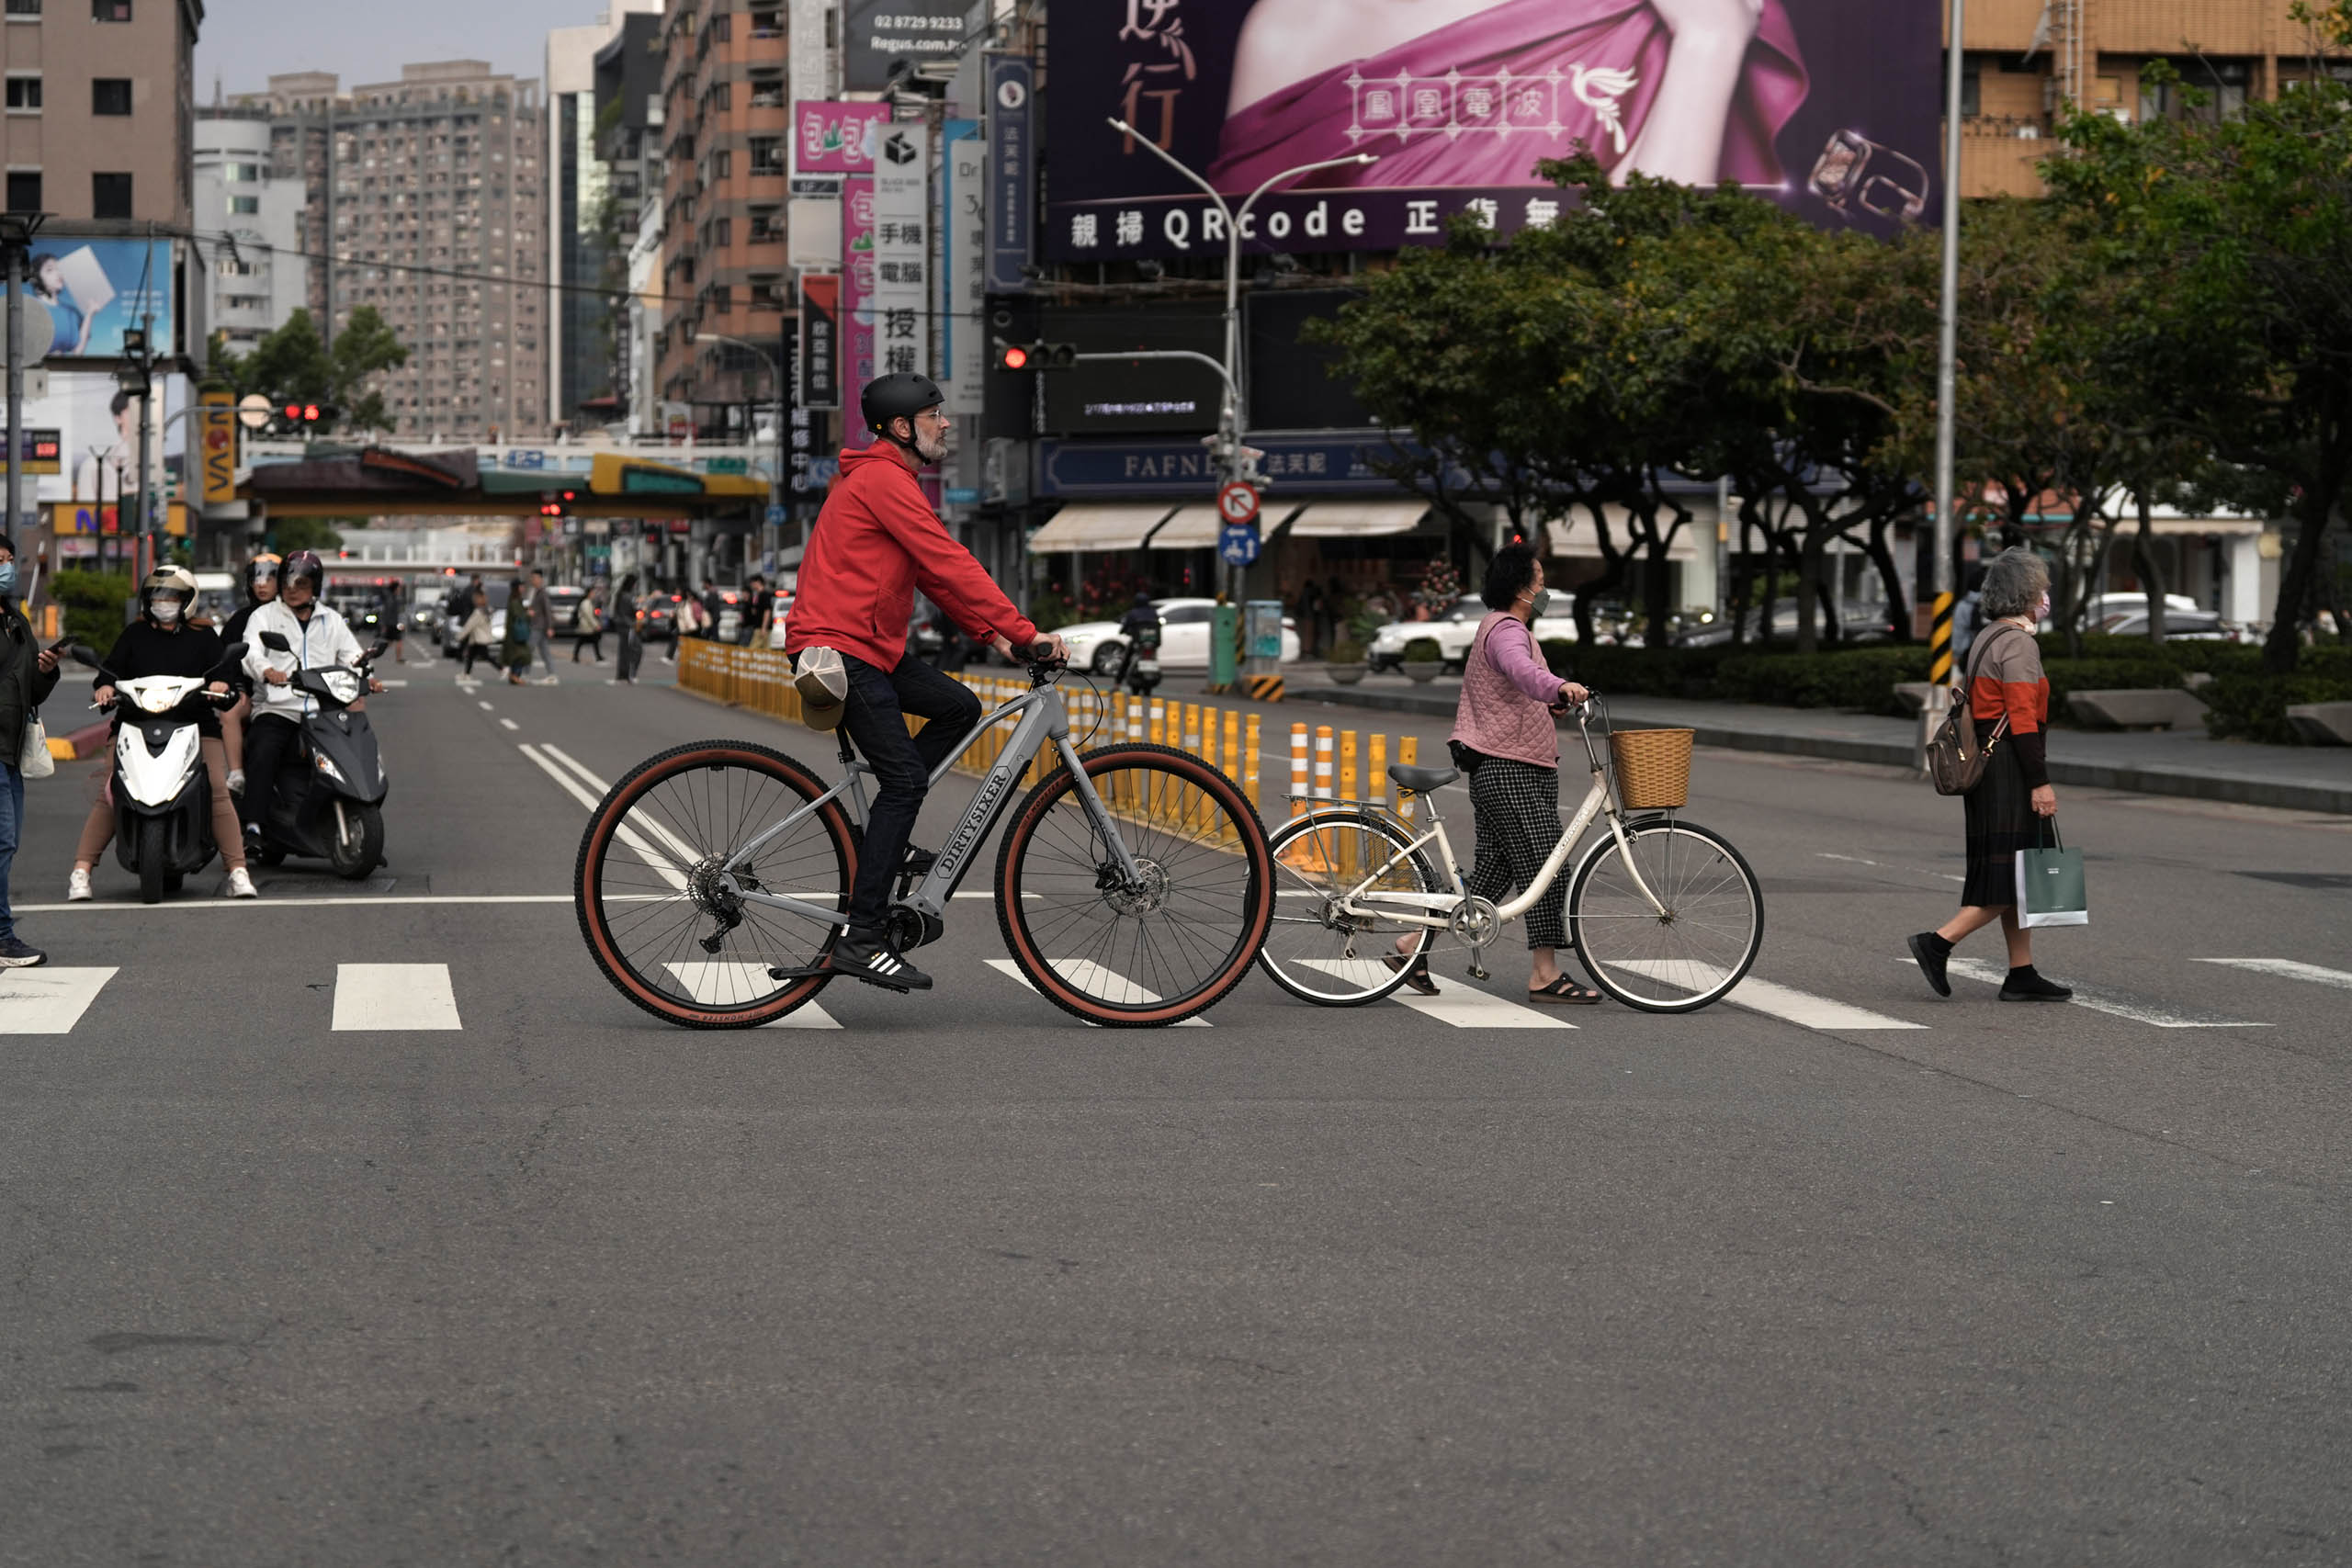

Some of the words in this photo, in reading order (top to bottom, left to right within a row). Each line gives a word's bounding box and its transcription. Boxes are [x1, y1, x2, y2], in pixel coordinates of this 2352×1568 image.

[875, 15, 892, 28] 02
[894, 16, 928, 29] 8729
[929, 16, 963, 29] 9233
[879, 222, 922, 243] 手機
[879, 261, 922, 283] 電腦
[1267, 453, 1326, 475] 法芙妮
[941, 773, 1007, 873] DIRTYSIXER
